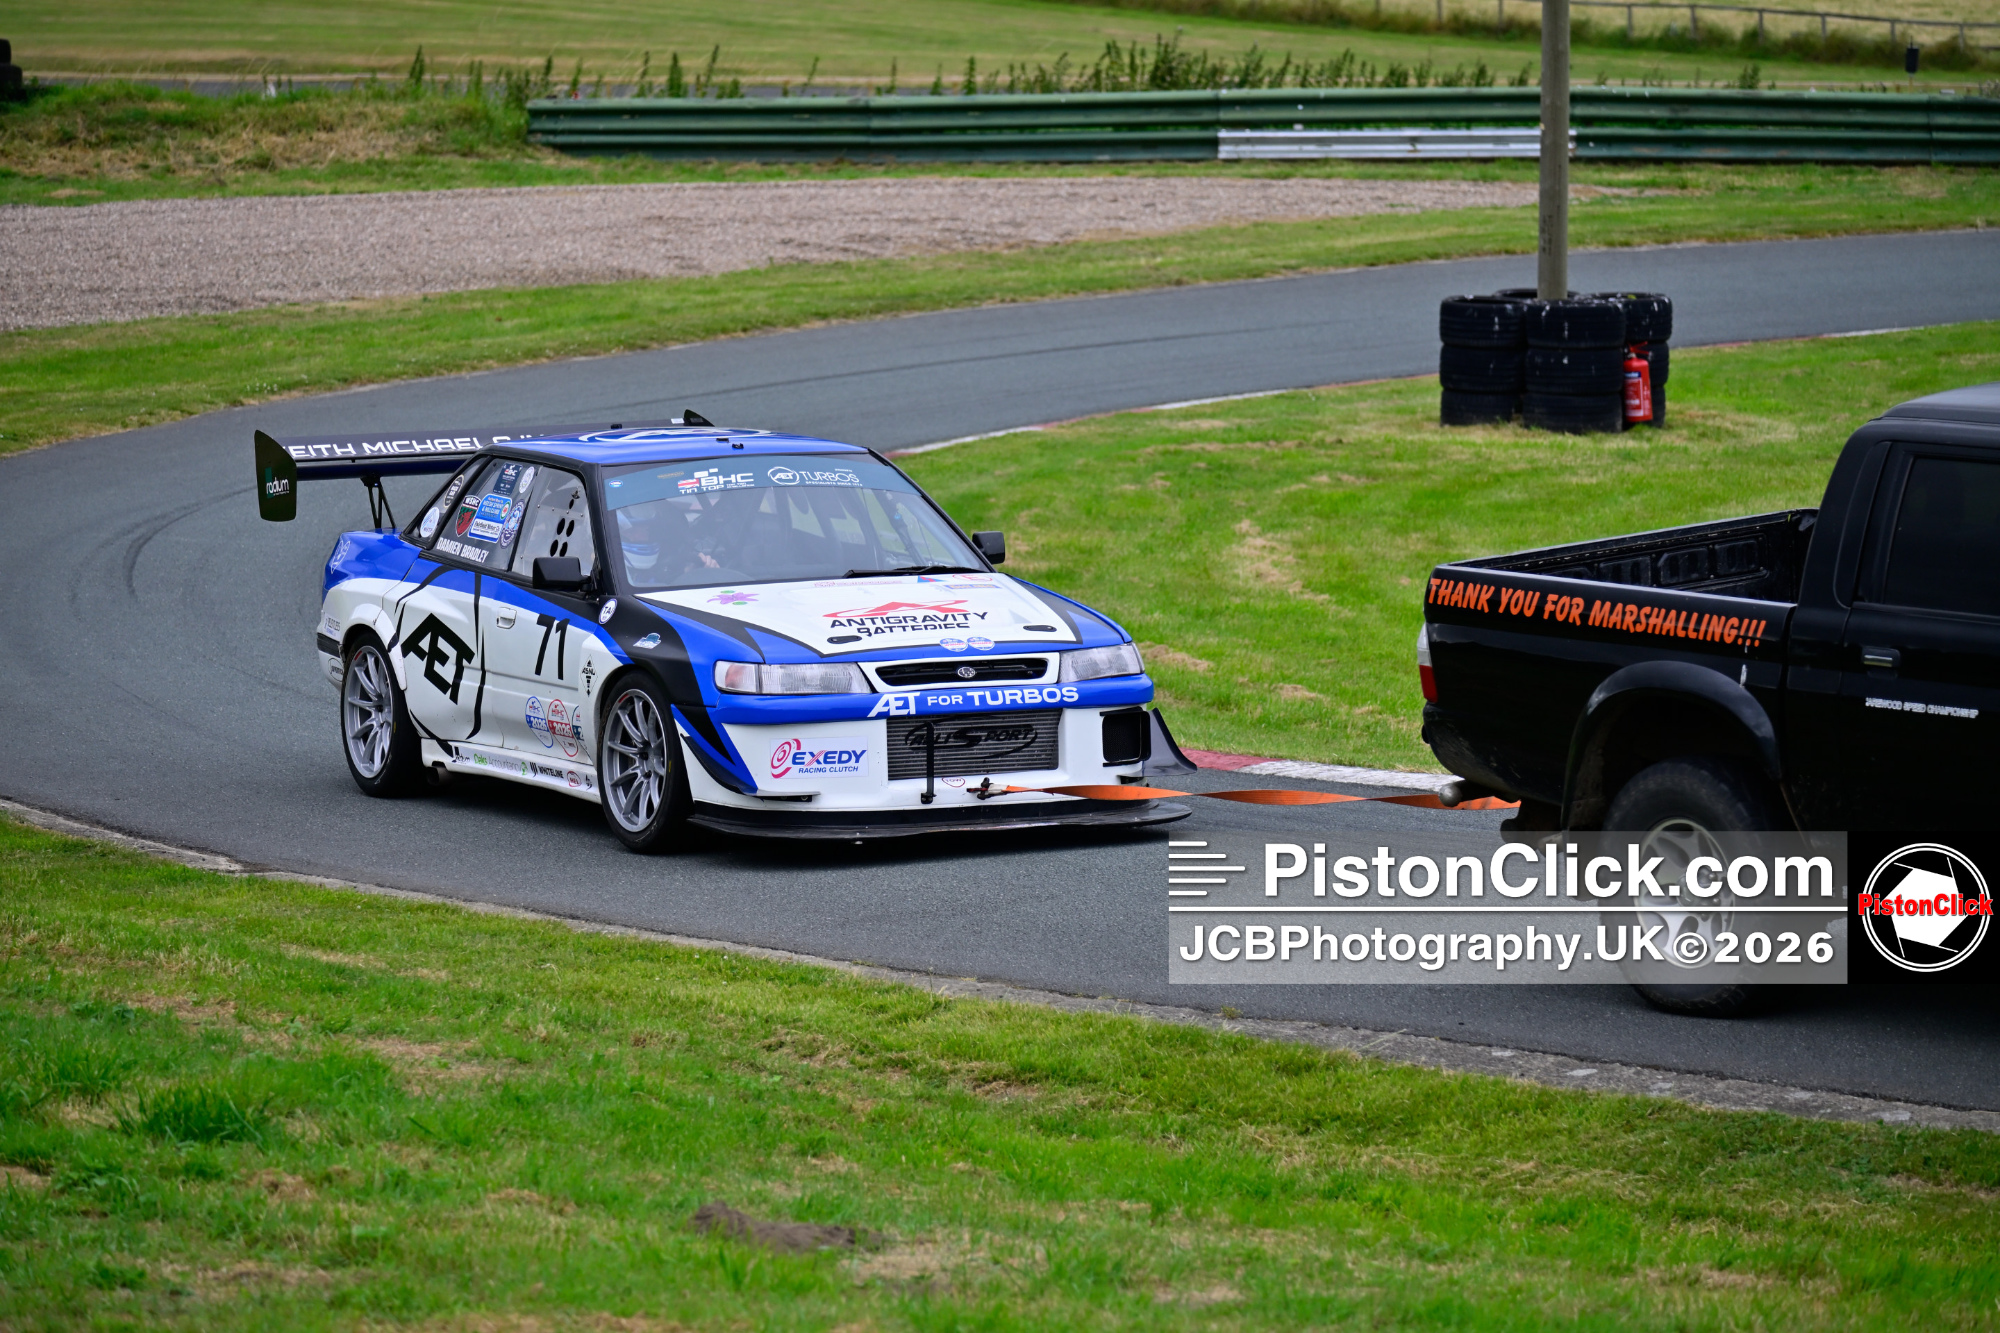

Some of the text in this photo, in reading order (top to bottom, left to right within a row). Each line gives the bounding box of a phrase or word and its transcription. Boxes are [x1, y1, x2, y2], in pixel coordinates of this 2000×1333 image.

[282, 443, 357, 458] EITH
[701, 472, 755, 487] BHC
[799, 471, 860, 484] TURBOS
[679, 487, 698, 495] TIN
[701, 484, 725, 492] TOP
[436, 538, 490, 563] DAMIEN BRADLEY
[830, 612, 989, 628] ANTIGRAVITY
[1428, 578, 1767, 647] THANK YOU FOR MARSHALLING!!!
[535, 613, 570, 680] 71
[401, 613, 475, 705] AET
[867, 686, 1079, 718] AET FOR TURBOS
[791, 749, 867, 767] EXEDY
[538, 765, 564, 779] WHITELINE
[798, 766, 827, 774] RACING
